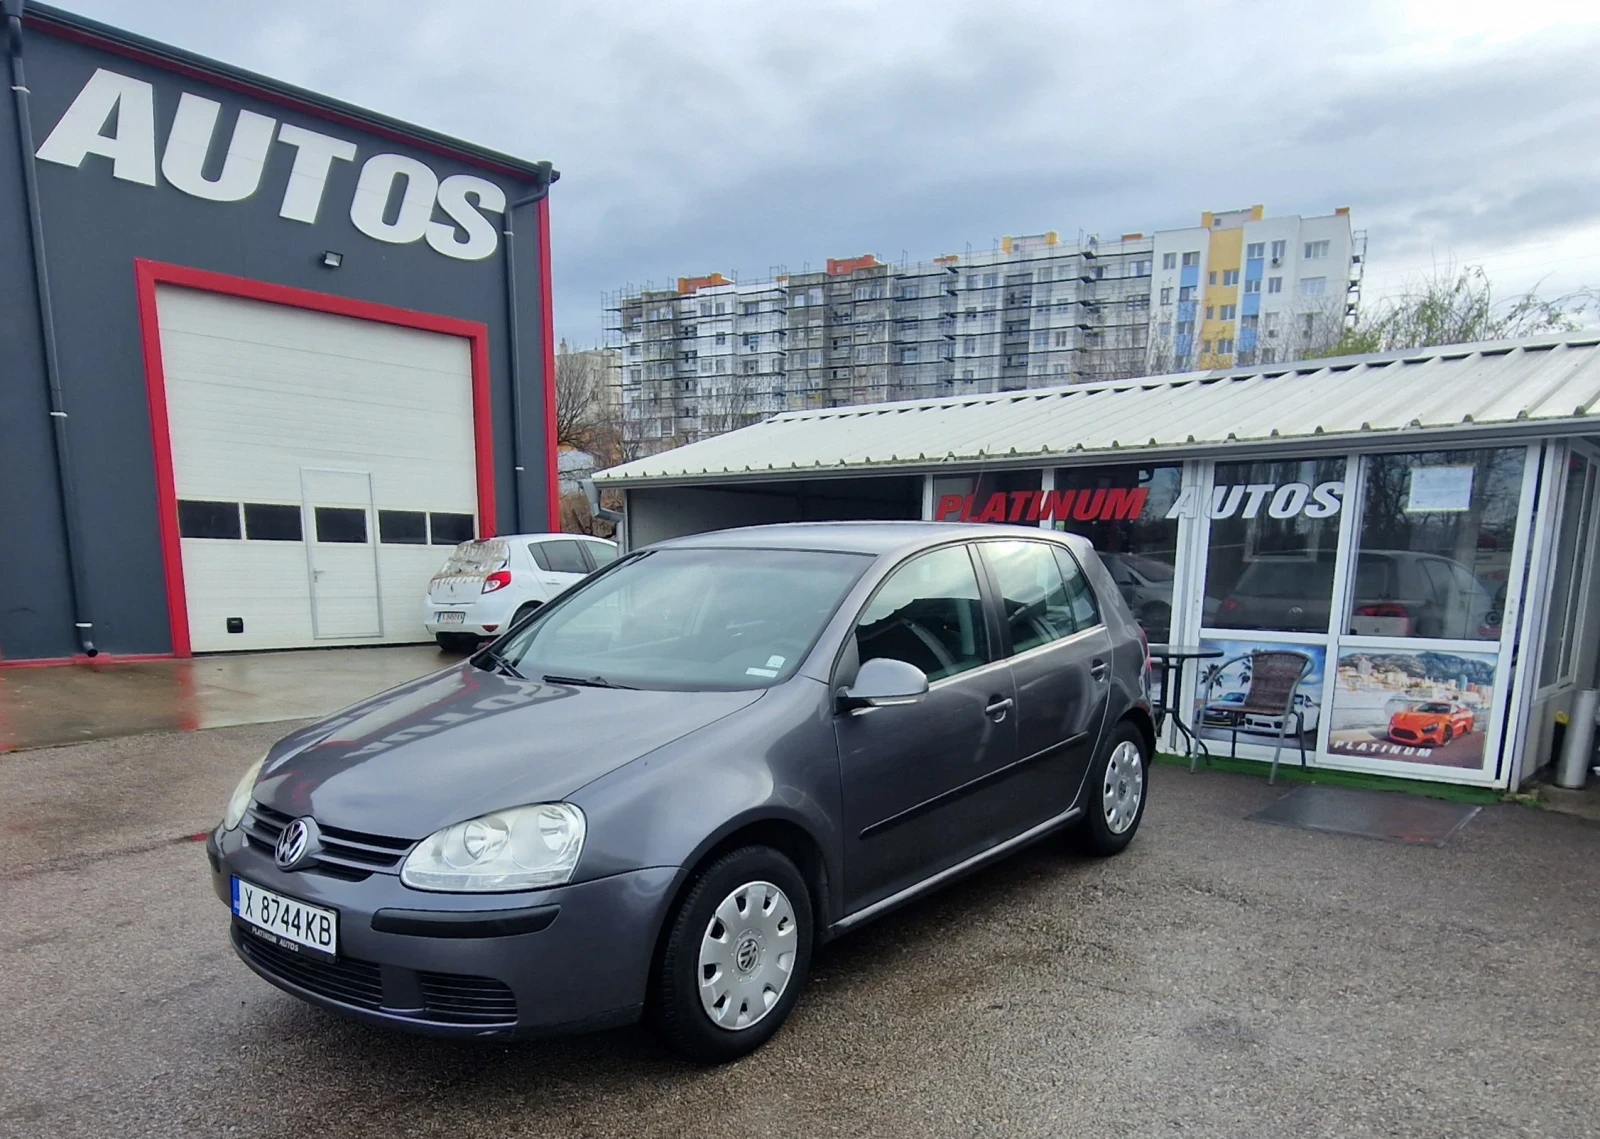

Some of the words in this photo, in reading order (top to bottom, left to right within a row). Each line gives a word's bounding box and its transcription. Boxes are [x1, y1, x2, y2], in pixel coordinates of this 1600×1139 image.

[35, 67, 507, 261] AUTOS
[935, 487, 1150, 523] PLATINUM
[1165, 480, 1345, 520] AUTOS
[1333, 739, 1434, 758] PLATINUM
[244, 886, 253, 918] X
[279, 938, 299, 952] AUTOS
